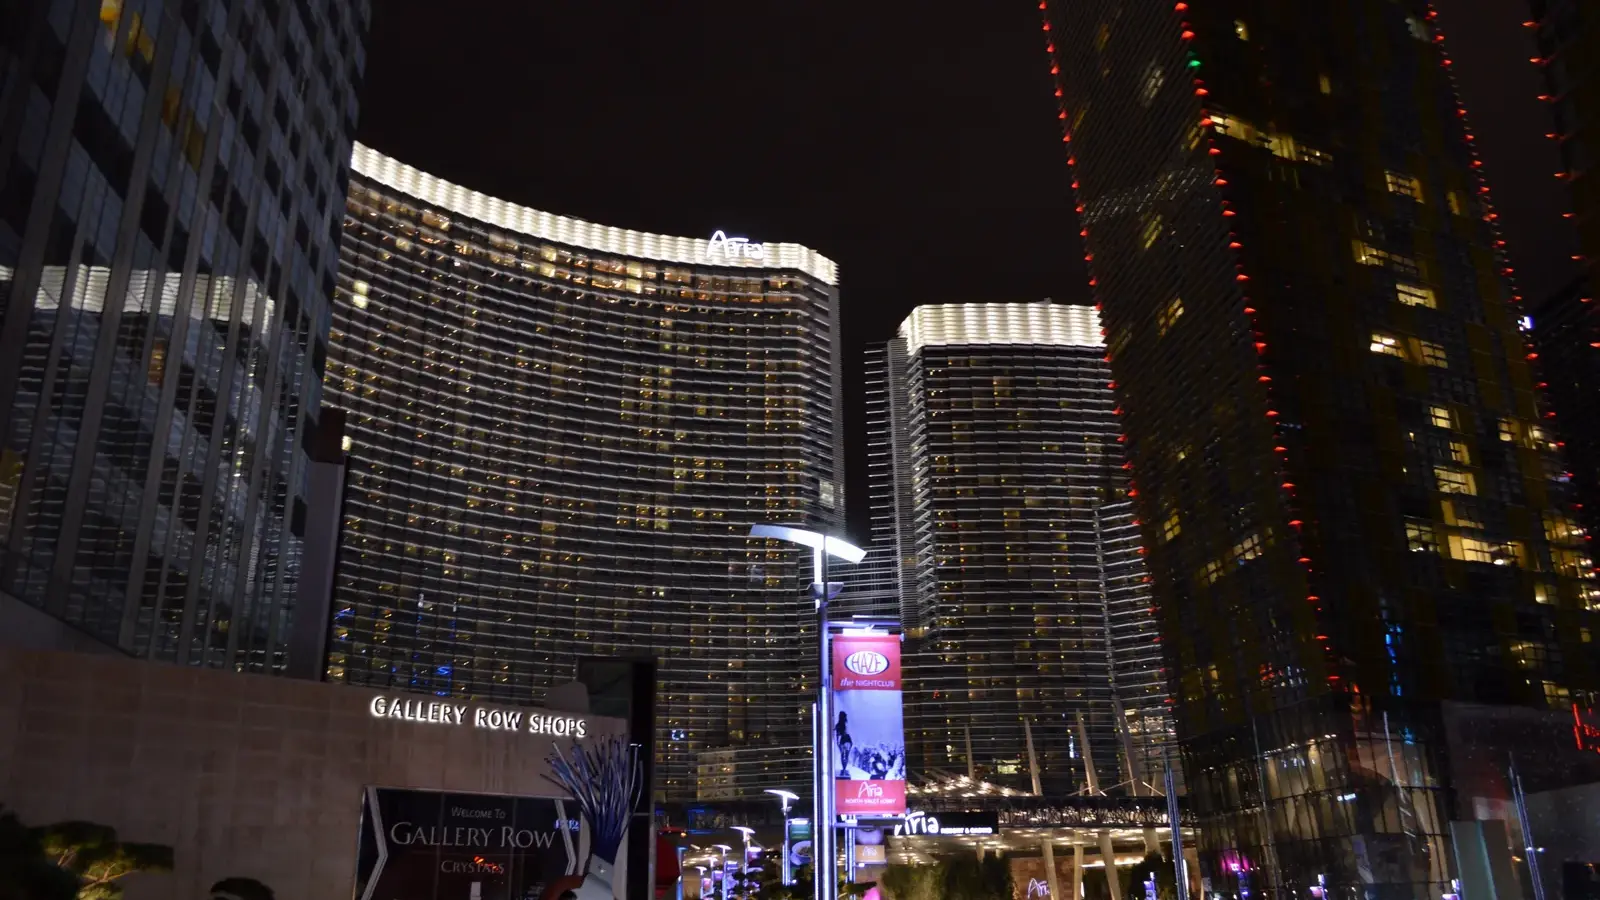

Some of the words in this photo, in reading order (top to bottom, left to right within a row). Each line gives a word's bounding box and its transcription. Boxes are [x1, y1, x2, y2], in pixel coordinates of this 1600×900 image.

[706, 230, 764, 259] Aria
[851, 652, 881, 673] HAZE
[840, 677, 854, 687] the
[370, 695, 467, 724] GALLERY
[474, 708, 523, 731] ROW
[529, 714, 588, 738] SHOPS
[858, 781, 883, 798] Aria
[451, 806, 493, 819] WELCOME
[494, 808, 506, 819] TO
[390, 821, 494, 847] GALLERY
[500, 826, 556, 849] ROW
[441, 860, 505, 875] CRYSTALS
